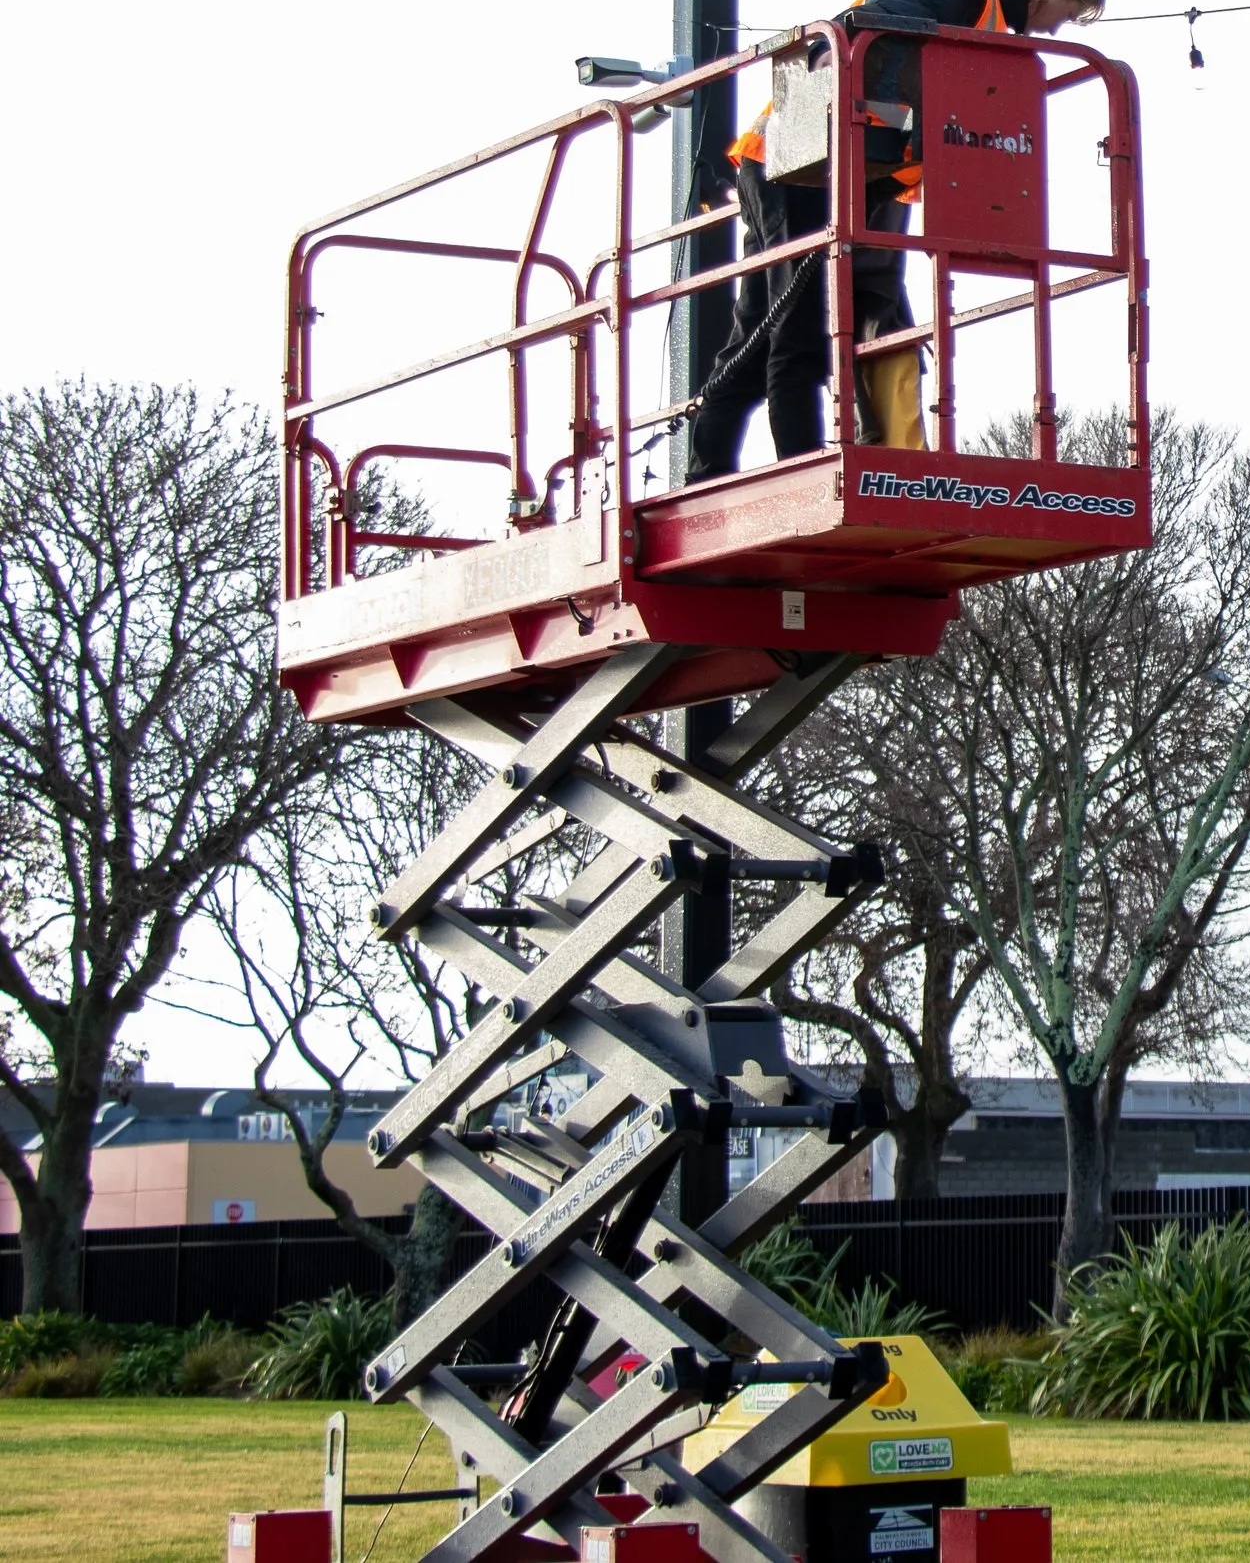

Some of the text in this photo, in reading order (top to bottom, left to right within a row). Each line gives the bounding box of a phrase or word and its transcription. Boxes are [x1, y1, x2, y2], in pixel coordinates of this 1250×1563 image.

[859, 471, 1136, 517] HireWays Access
[727, 1137, 749, 1156] EASE
[583, 1143, 636, 1200] Access
[871, 1408, 917, 1422] Only
[874, 1538, 930, 1550] CITY COUNCIL
